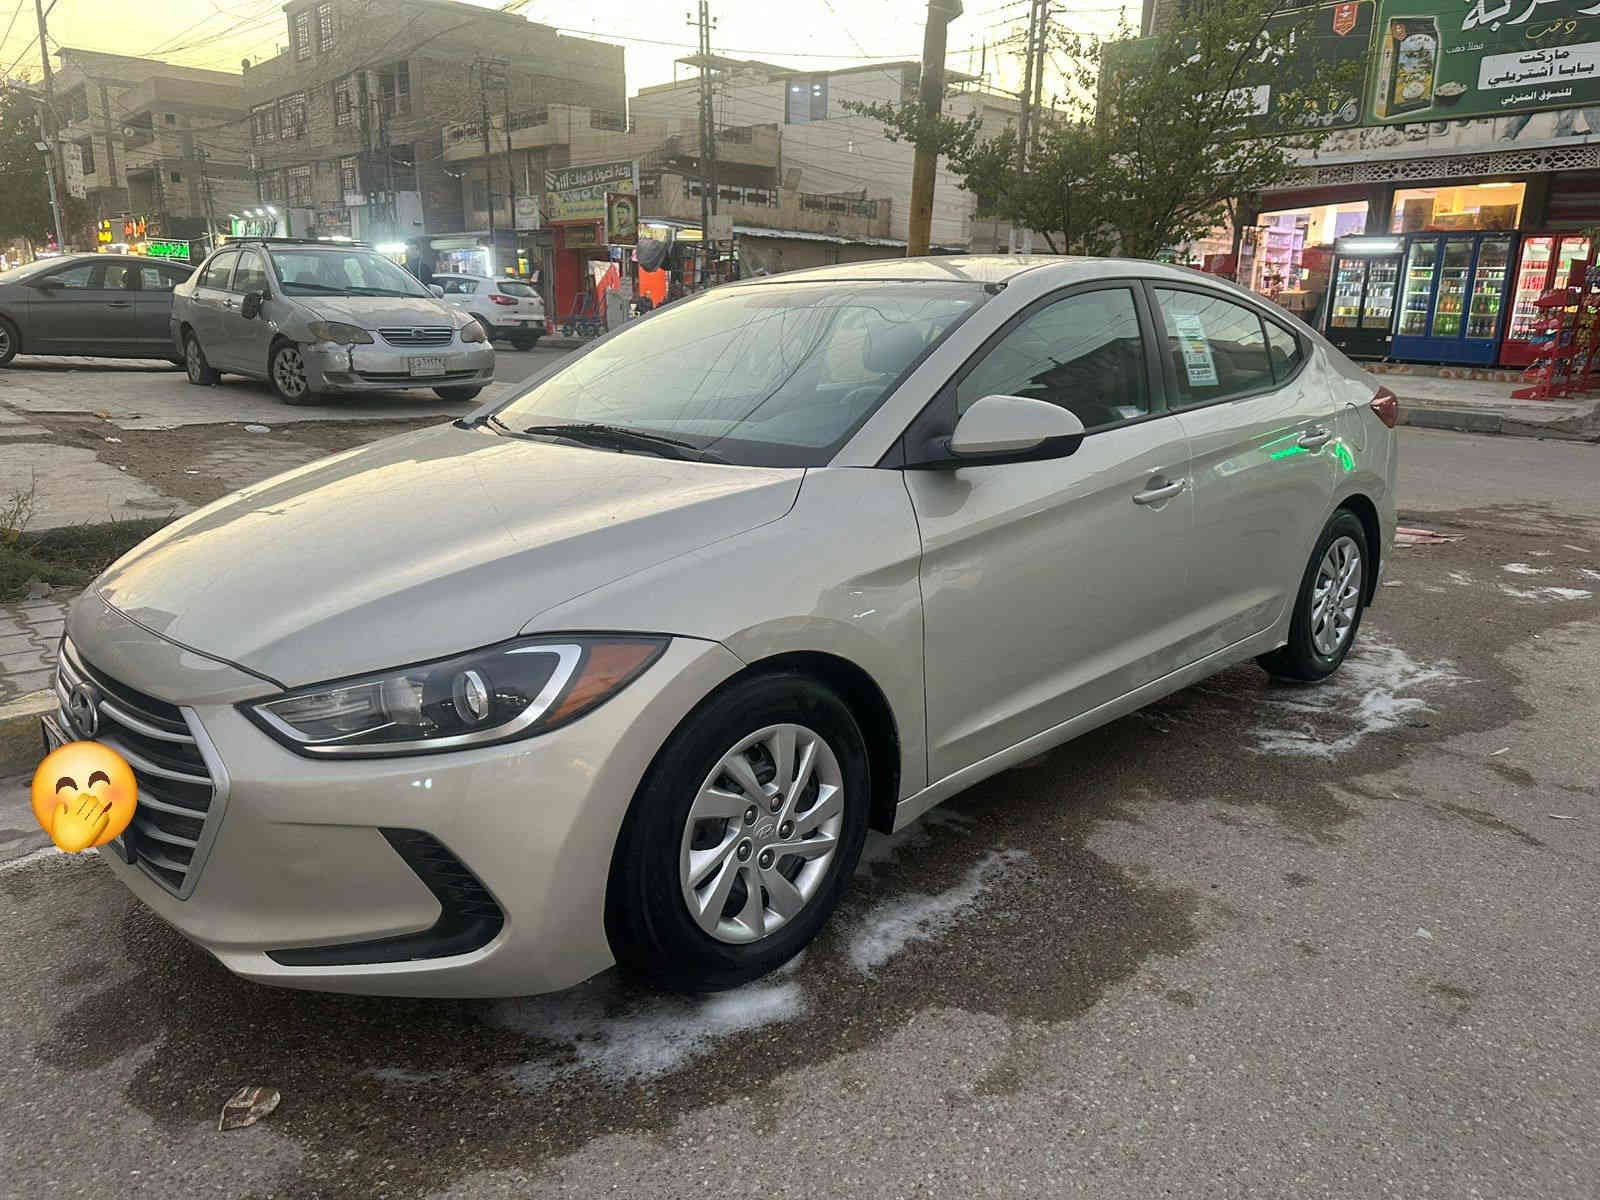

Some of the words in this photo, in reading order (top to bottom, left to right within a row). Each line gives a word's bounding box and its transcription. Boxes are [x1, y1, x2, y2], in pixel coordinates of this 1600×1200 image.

[1519, 48, 1570, 64] ماركت
[1558, 62, 1595, 77] بابا
[1500, 91, 1537, 106] المنزلي
[1538, 87, 1573, 102] للتسوق
